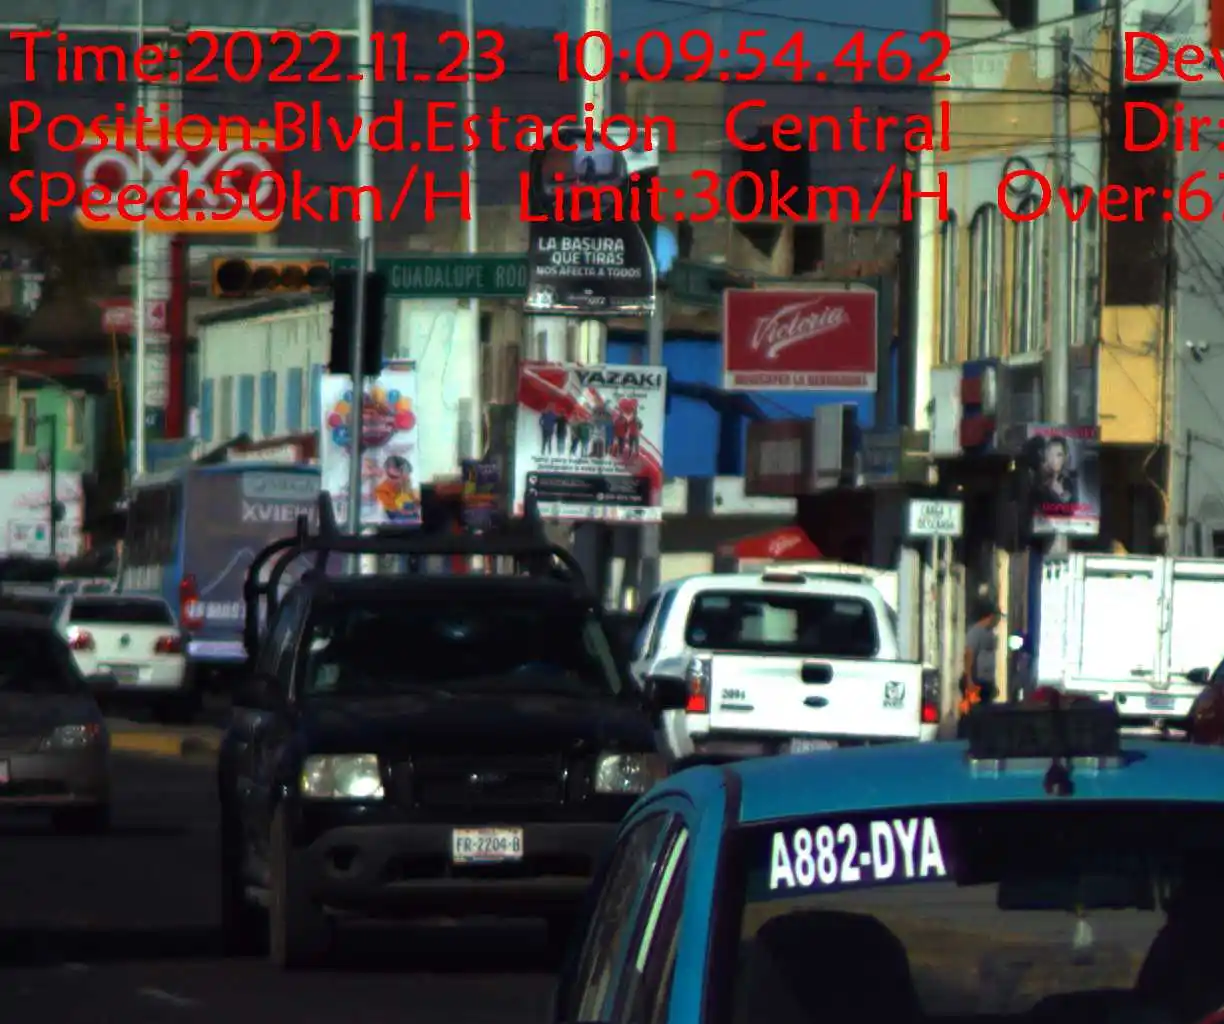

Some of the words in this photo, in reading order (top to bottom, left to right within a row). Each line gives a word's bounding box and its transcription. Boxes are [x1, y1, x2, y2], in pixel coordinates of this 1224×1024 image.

[538, 237, 557, 251] LA
[561, 237, 625, 251] BASURA
[552, 251, 581, 266] QUE
[584, 252, 625, 265] TIRAS
[391, 265, 485, 288] GUADALUPE
[751, 296, 848, 358] Victoria
[576, 371, 662, 387] YAZAKI
[769, 816, 948, 890] A882-DYA
